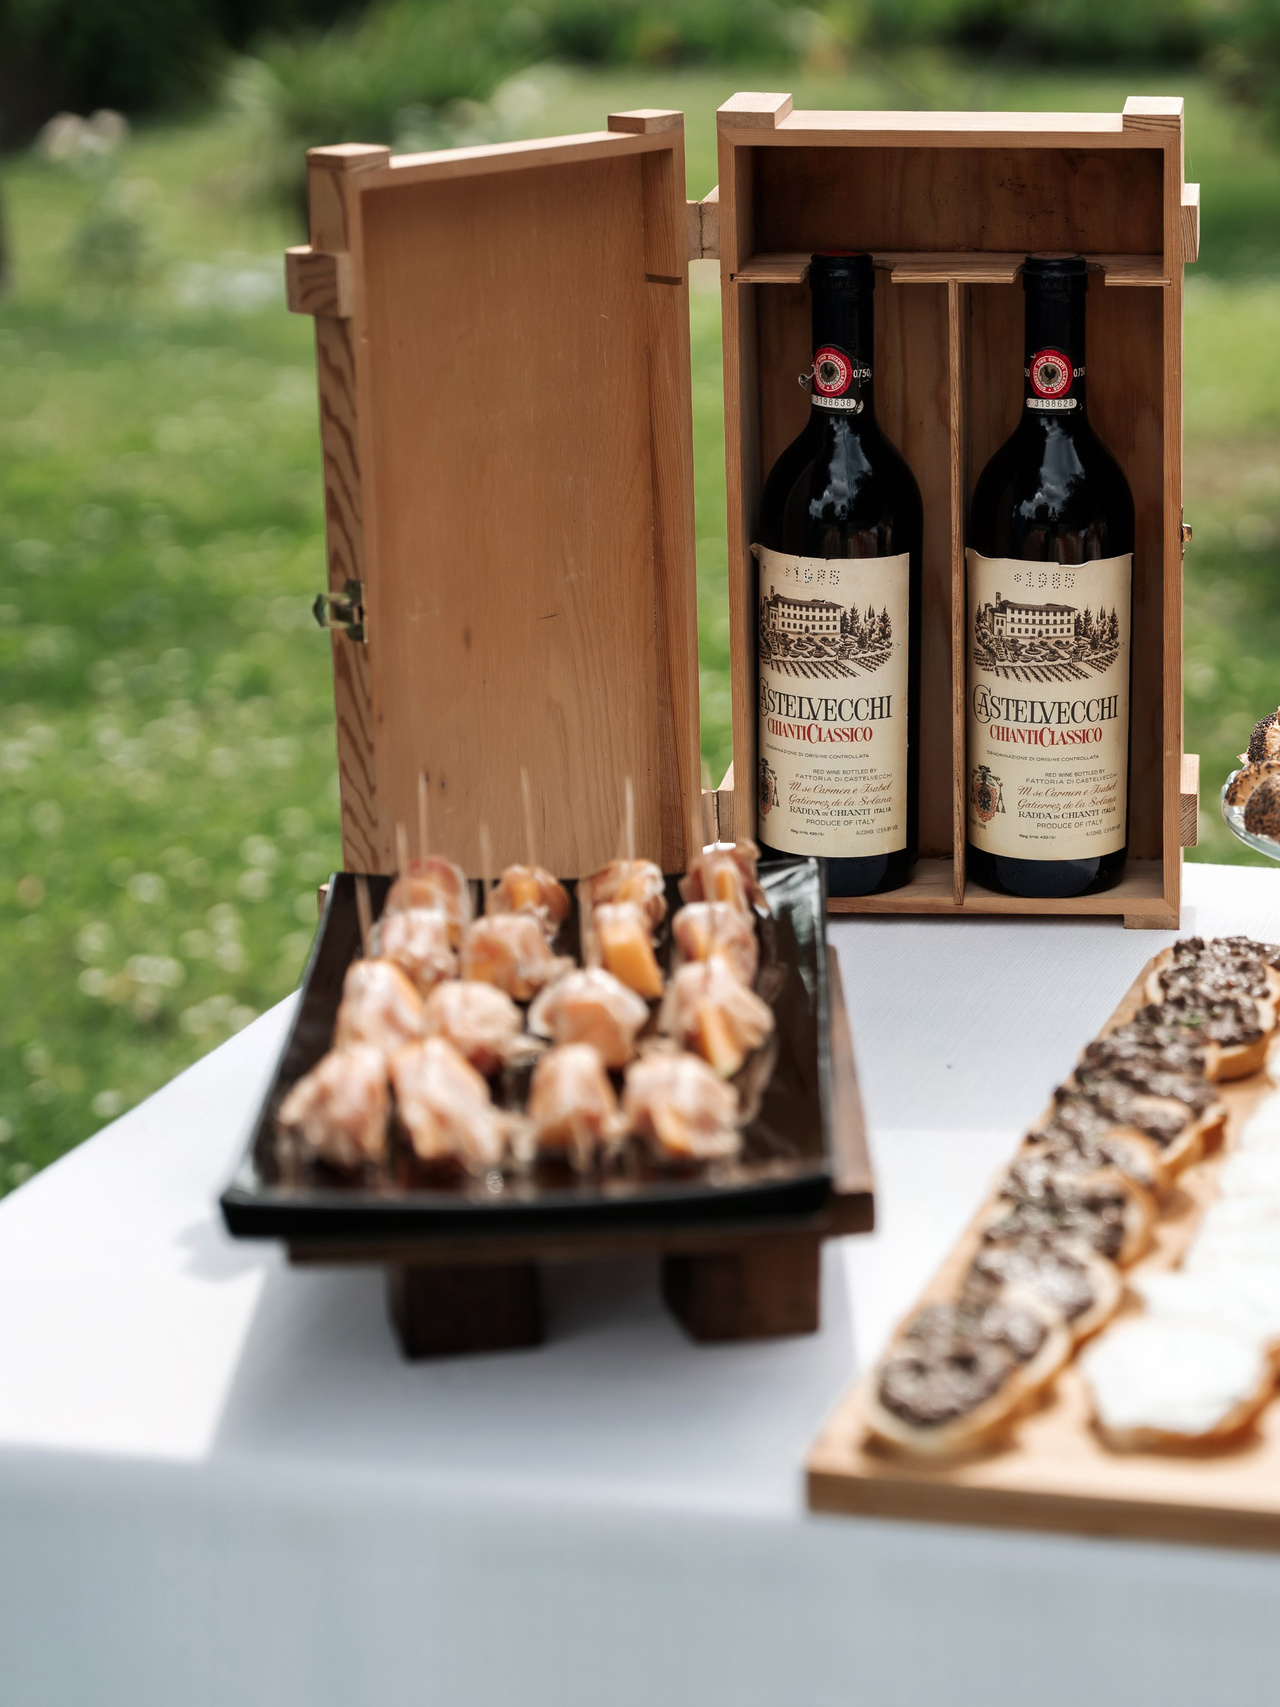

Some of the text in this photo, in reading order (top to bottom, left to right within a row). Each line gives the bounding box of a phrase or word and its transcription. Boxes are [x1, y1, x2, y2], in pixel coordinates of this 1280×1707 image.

[973, 684, 1119, 724] CASTELVECCHI
[1061, 754, 1099, 762] CONTROLLATA
[844, 773, 892, 782] CASTELVECCHI
[813, 784, 851, 794] Carmen
[1044, 788, 1083, 797] Carmen
[790, 806, 820, 816] RADDA
[830, 808, 871, 816] CHIANTI
[873, 806, 892, 814] ITALIA
[1018, 810, 1052, 820] RADDA
[1061, 809, 1100, 819] CHIANTI
[806, 818, 841, 826] PRODUCE
